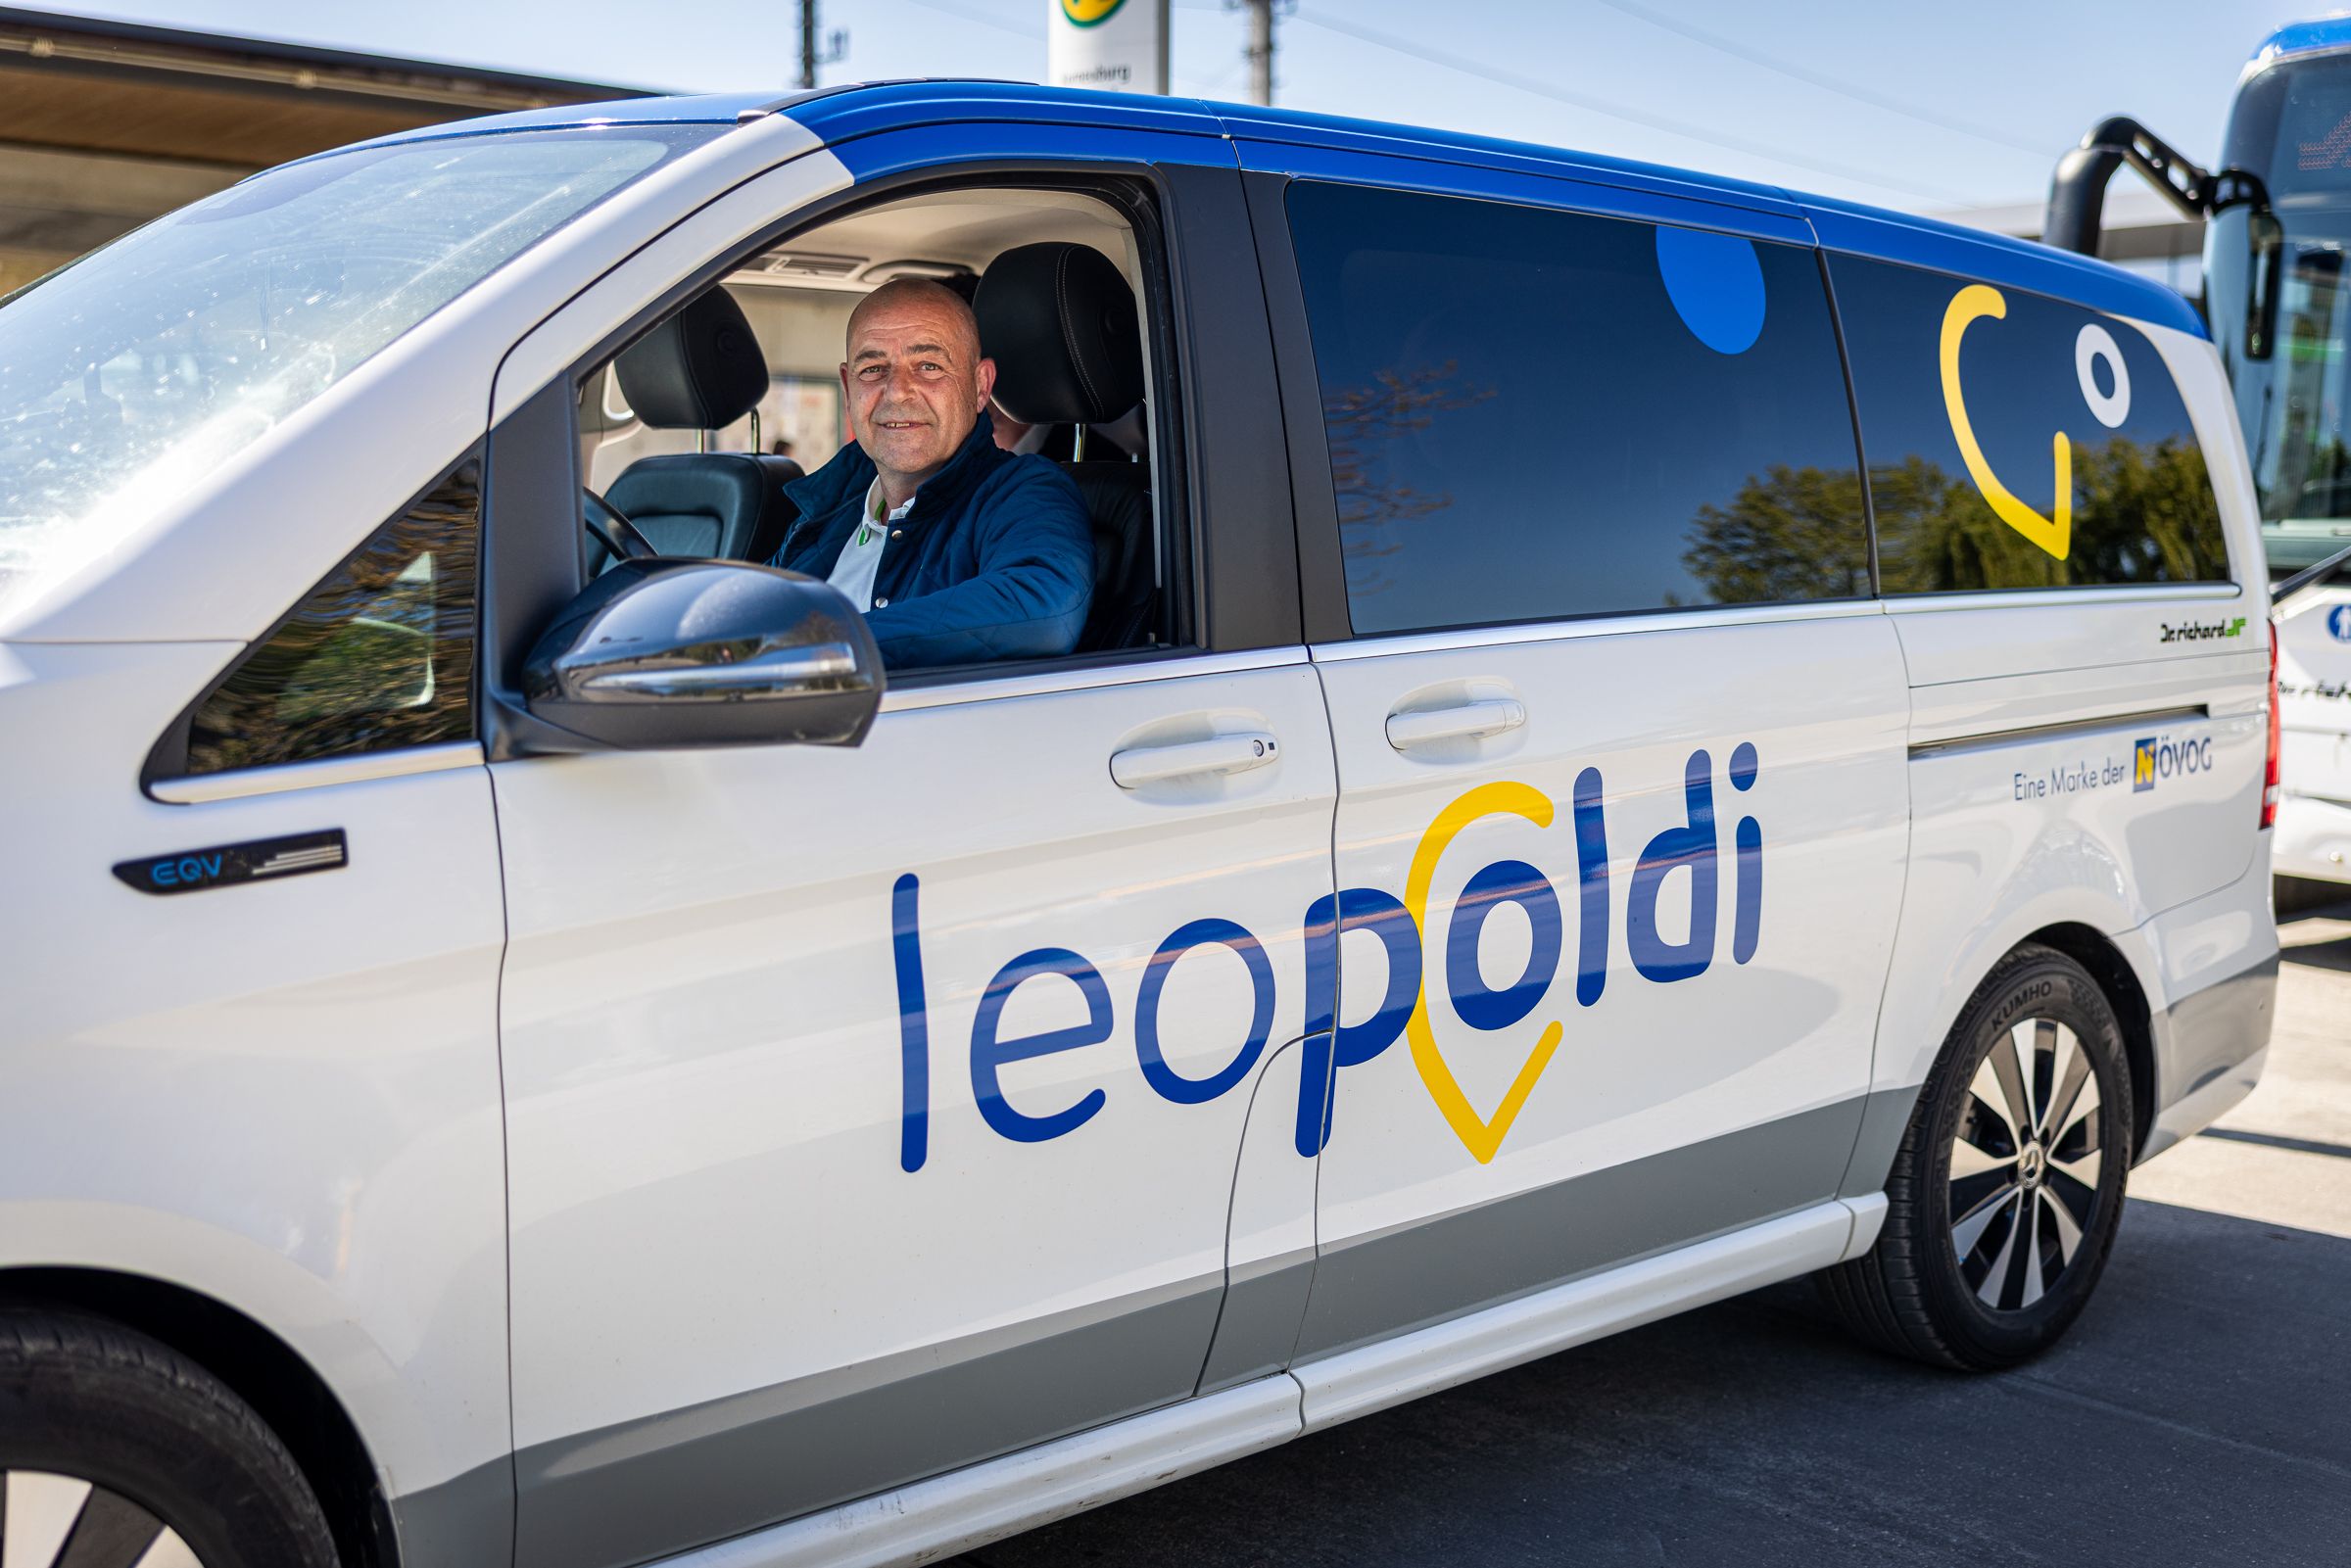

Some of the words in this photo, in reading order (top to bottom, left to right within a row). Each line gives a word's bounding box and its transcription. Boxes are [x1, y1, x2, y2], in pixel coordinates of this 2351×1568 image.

[2014, 772, 2046, 800] Eine
[2050, 760, 2097, 794] Marke
[2101, 756, 2125, 785] der
[152, 853, 223, 885] EQV
[891, 741, 1762, 1173] leopoldi
[1991, 980, 2053, 1031] KUMHO
